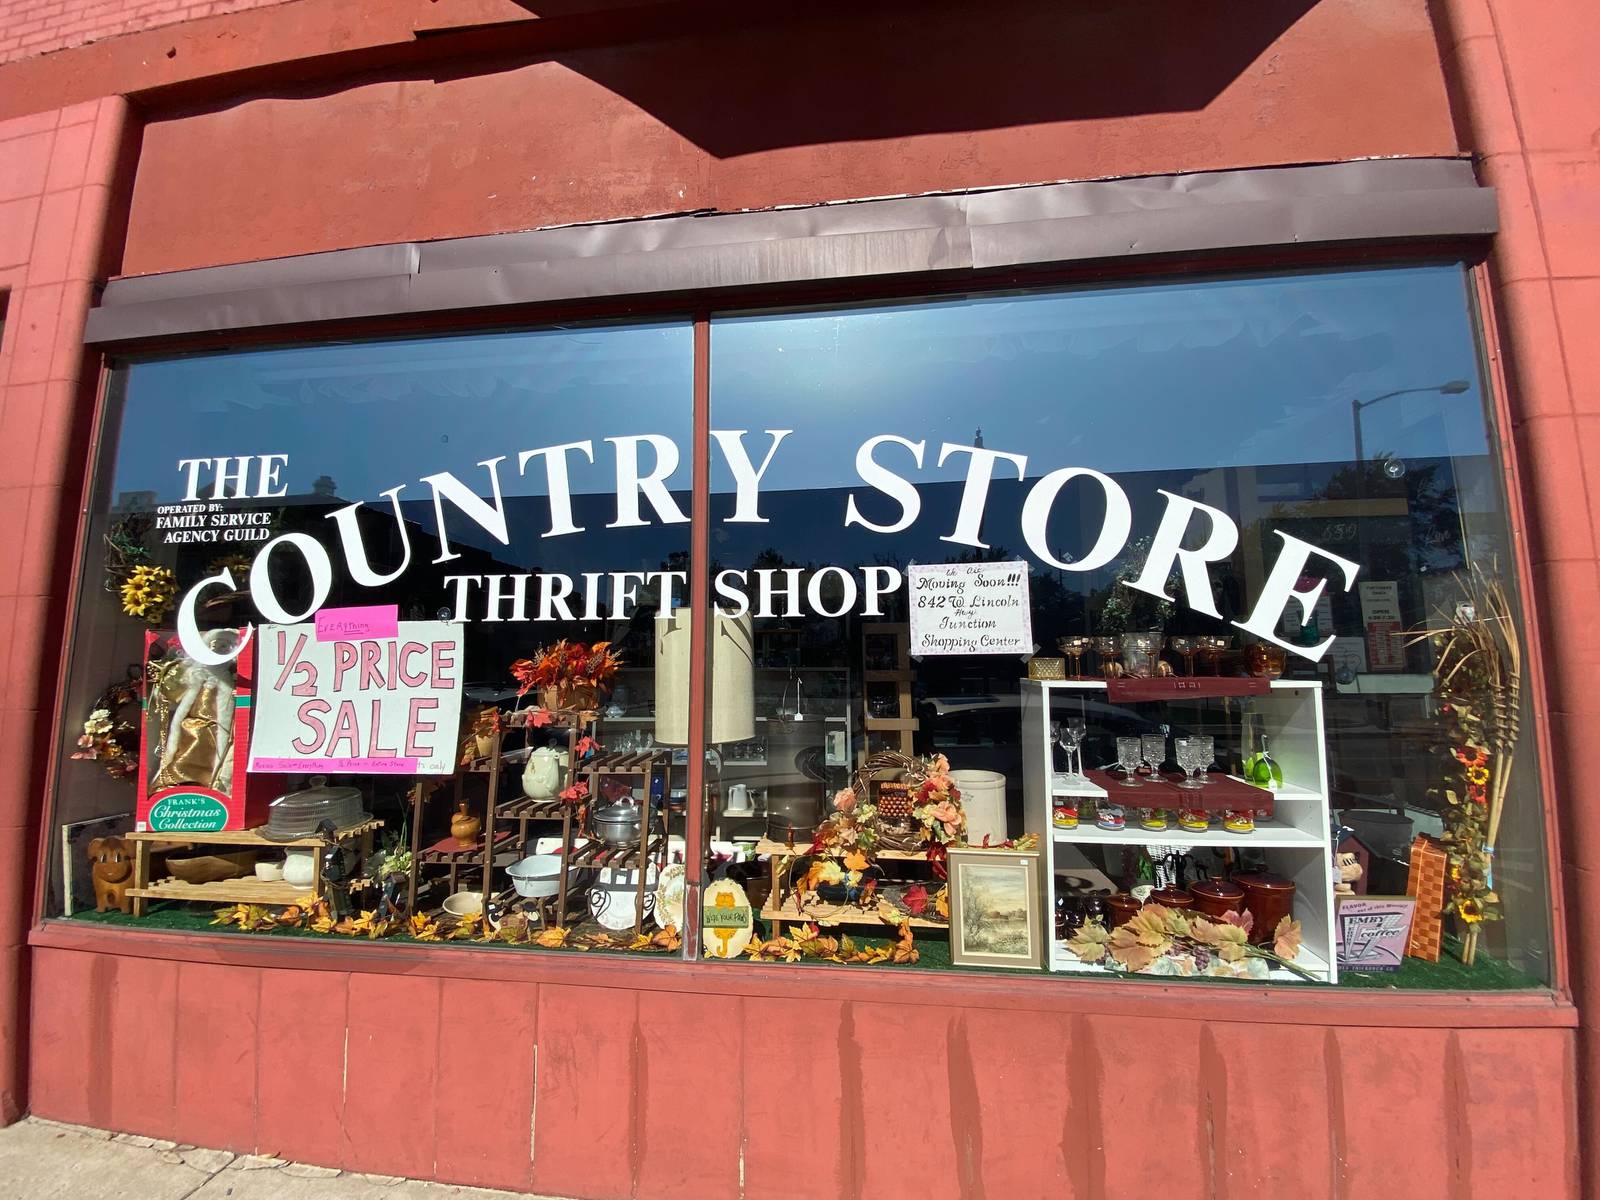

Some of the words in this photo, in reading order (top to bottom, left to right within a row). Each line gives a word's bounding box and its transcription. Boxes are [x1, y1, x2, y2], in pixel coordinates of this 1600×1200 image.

[178, 454, 289, 501] THE
[157, 504, 206, 514] OPERATED
[209, 503, 224, 512] BY:
[156, 514, 207, 529] FAMILY
[211, 512, 271, 526] SERVICE
[164, 529, 220, 543] AGENCY
[224, 528, 270, 541] GUILD
[178, 429, 793, 666] COUNTRY
[845, 434, 1361, 663] STORE
[916, 577, 966, 594] Moving
[974, 573, 1021, 588] Soon!!!
[444, 571, 687, 623] THRIFT
[714, 566, 902, 618] SHOP
[918, 595, 946, 608] 842
[970, 594, 1019, 608] Lincoln
[939, 617, 997, 630] Junction
[921, 634, 977, 652] Shopping
[980, 634, 1021, 647] Center
[333, 641, 455, 692] PRICE
[292, 698, 439, 758] SALE
[167, 798, 206, 806] FRANK'S
[154, 804, 222, 818] Christmas
[159, 818, 217, 830] Collection
[1342, 902, 1367, 910] FLAVOR
[1360, 929, 1400, 938] coffee
